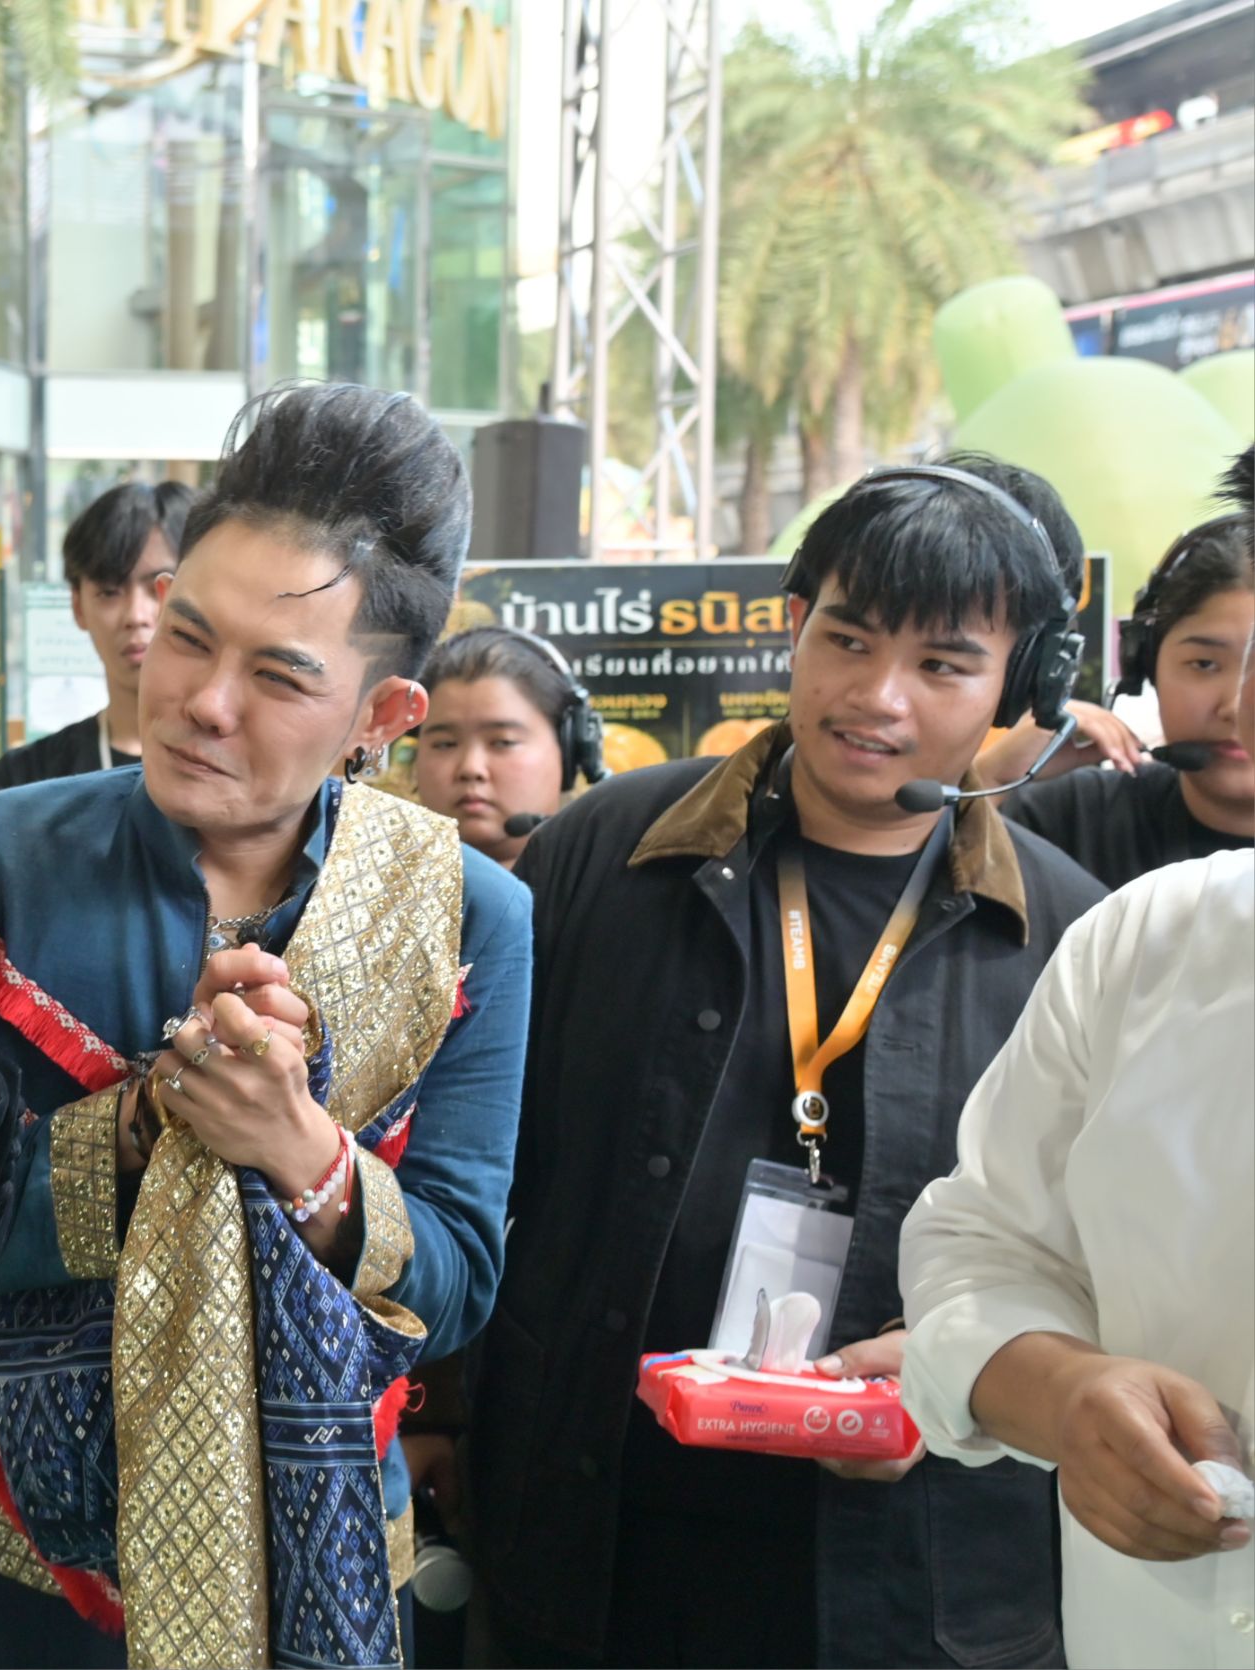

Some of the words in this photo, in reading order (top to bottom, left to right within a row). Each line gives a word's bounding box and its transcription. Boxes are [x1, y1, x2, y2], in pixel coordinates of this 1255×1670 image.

[659, 591, 793, 635] ธนิส
[788, 909, 807, 970] #TEAMB
[696, 1417, 737, 1432] EXTRA
[739, 1420, 796, 1436] HYGIENE
